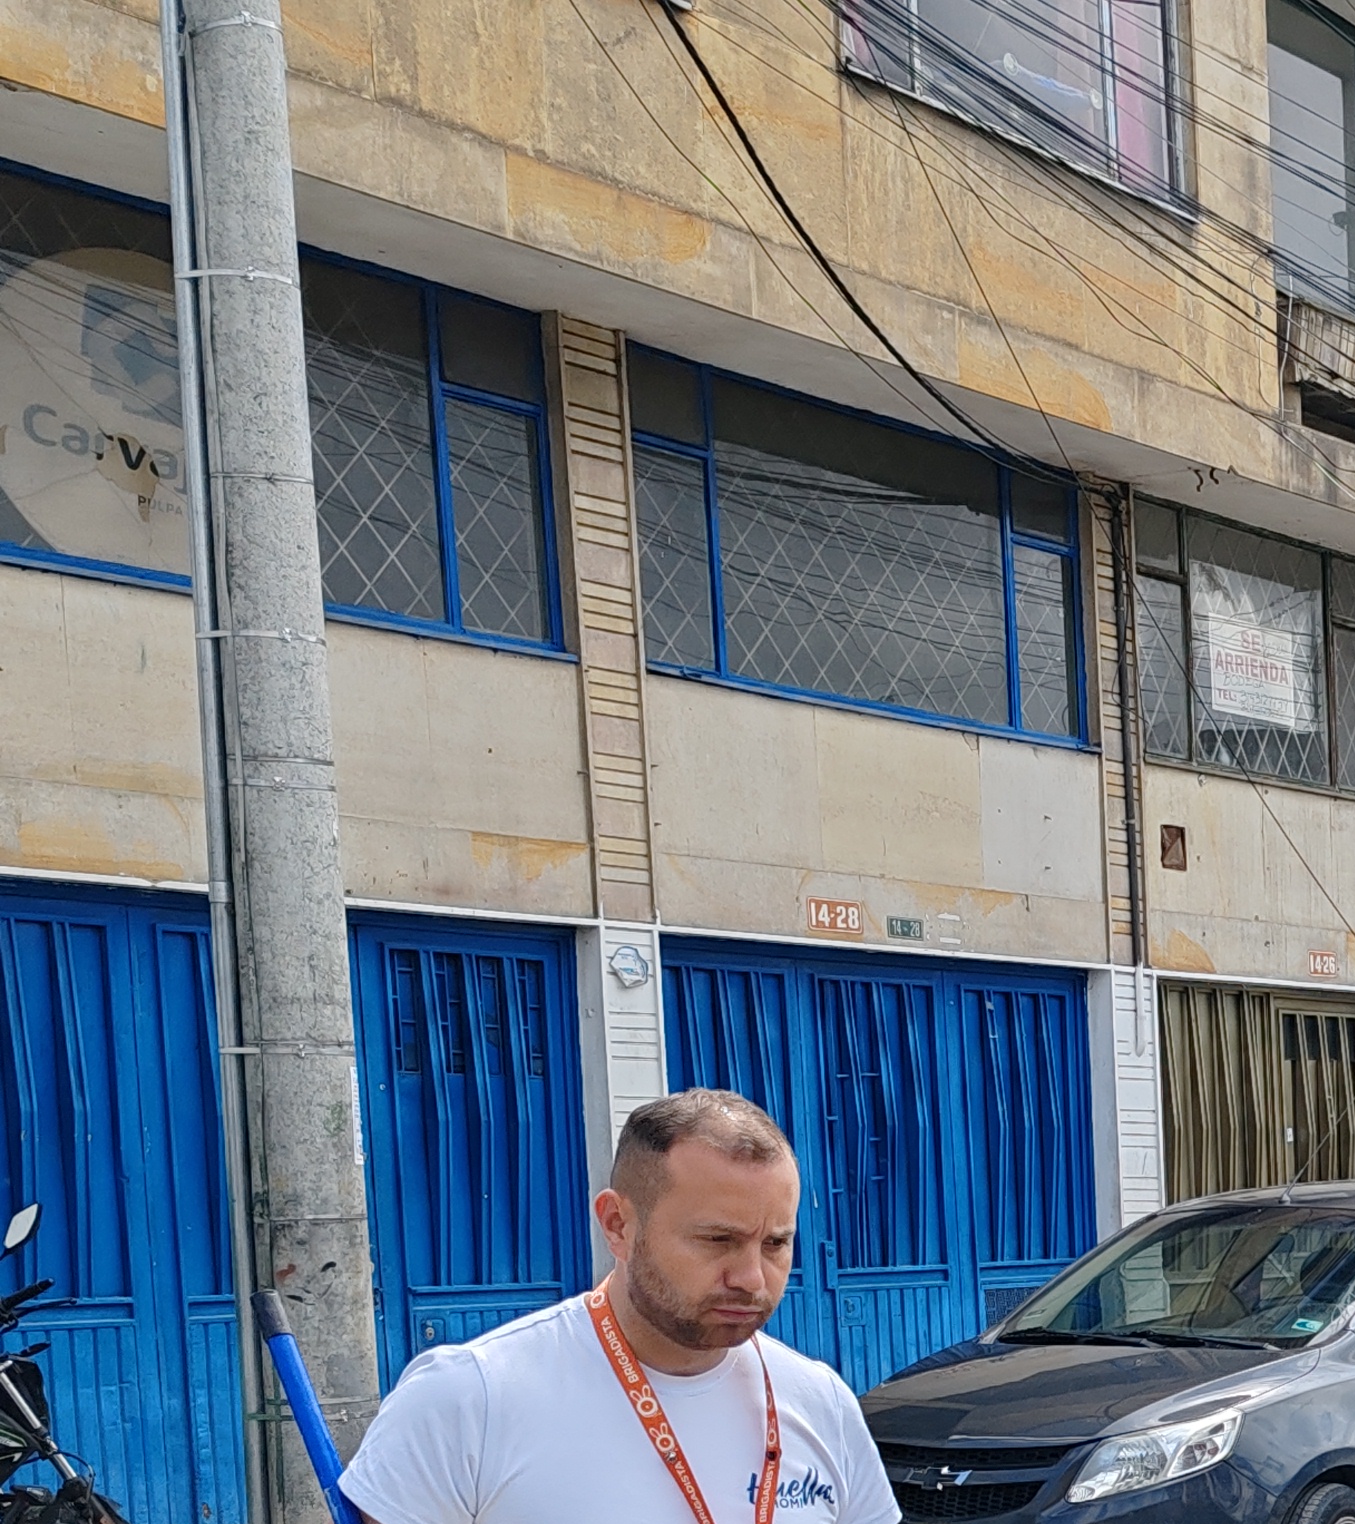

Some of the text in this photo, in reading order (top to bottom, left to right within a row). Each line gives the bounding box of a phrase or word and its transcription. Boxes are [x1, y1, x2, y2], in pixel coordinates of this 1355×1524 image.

[1240, 630, 1261, 652] SE
[1215, 650, 1288, 685] ARRIENDA
[810, 902, 860, 930] 14-28
[891, 919, 920, 937] 14-28
[1310, 954, 1336, 974] 14-26
[600, 1315, 640, 1385] BRIGADISTA
[760, 1460, 776, 1523] BRIGADIST
